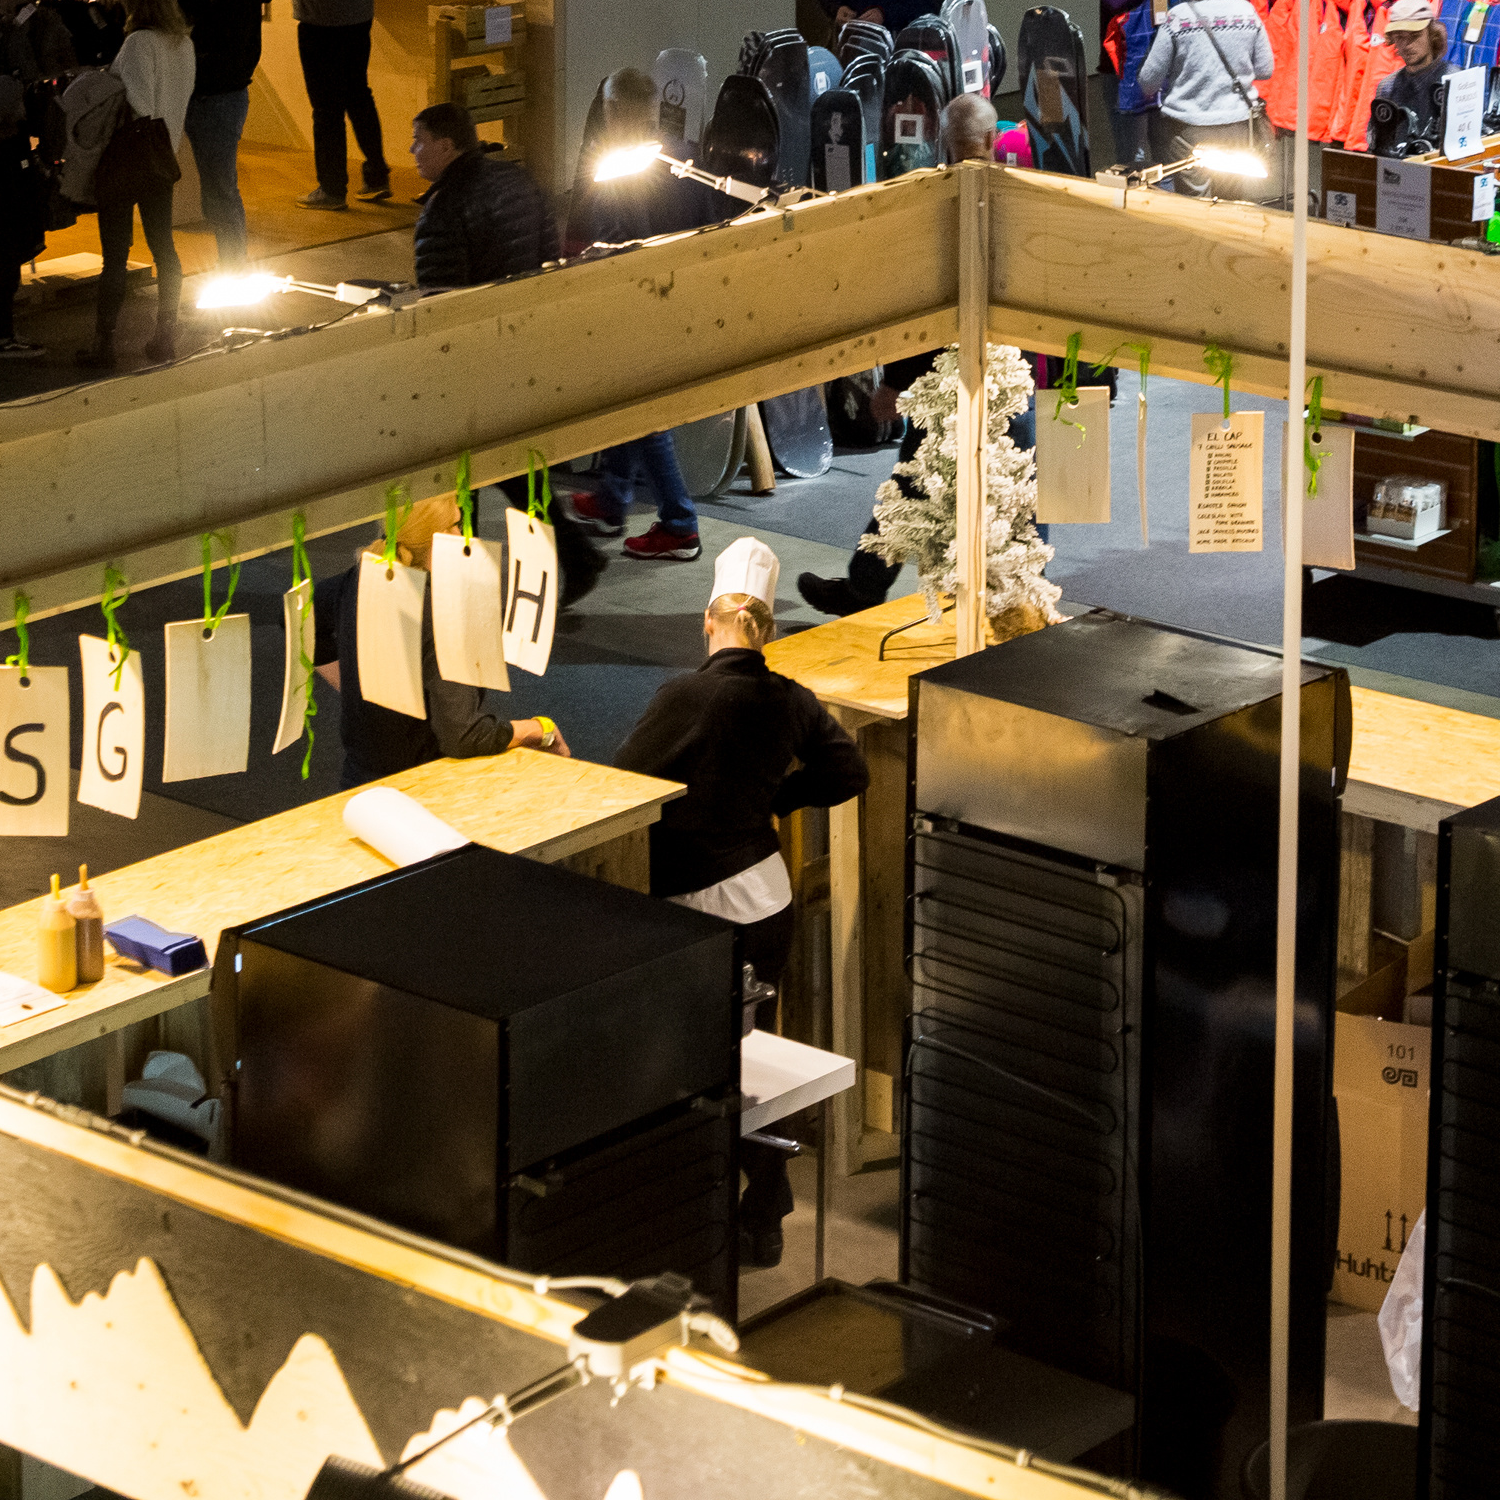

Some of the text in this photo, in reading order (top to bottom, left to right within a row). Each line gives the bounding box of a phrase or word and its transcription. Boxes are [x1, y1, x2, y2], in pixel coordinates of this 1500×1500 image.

[1206, 432, 1244, 442] EL CAP
[95, 700, 128, 782] G
[504, 558, 548, 644] H
[1387, 1043, 1415, 1061] 101
